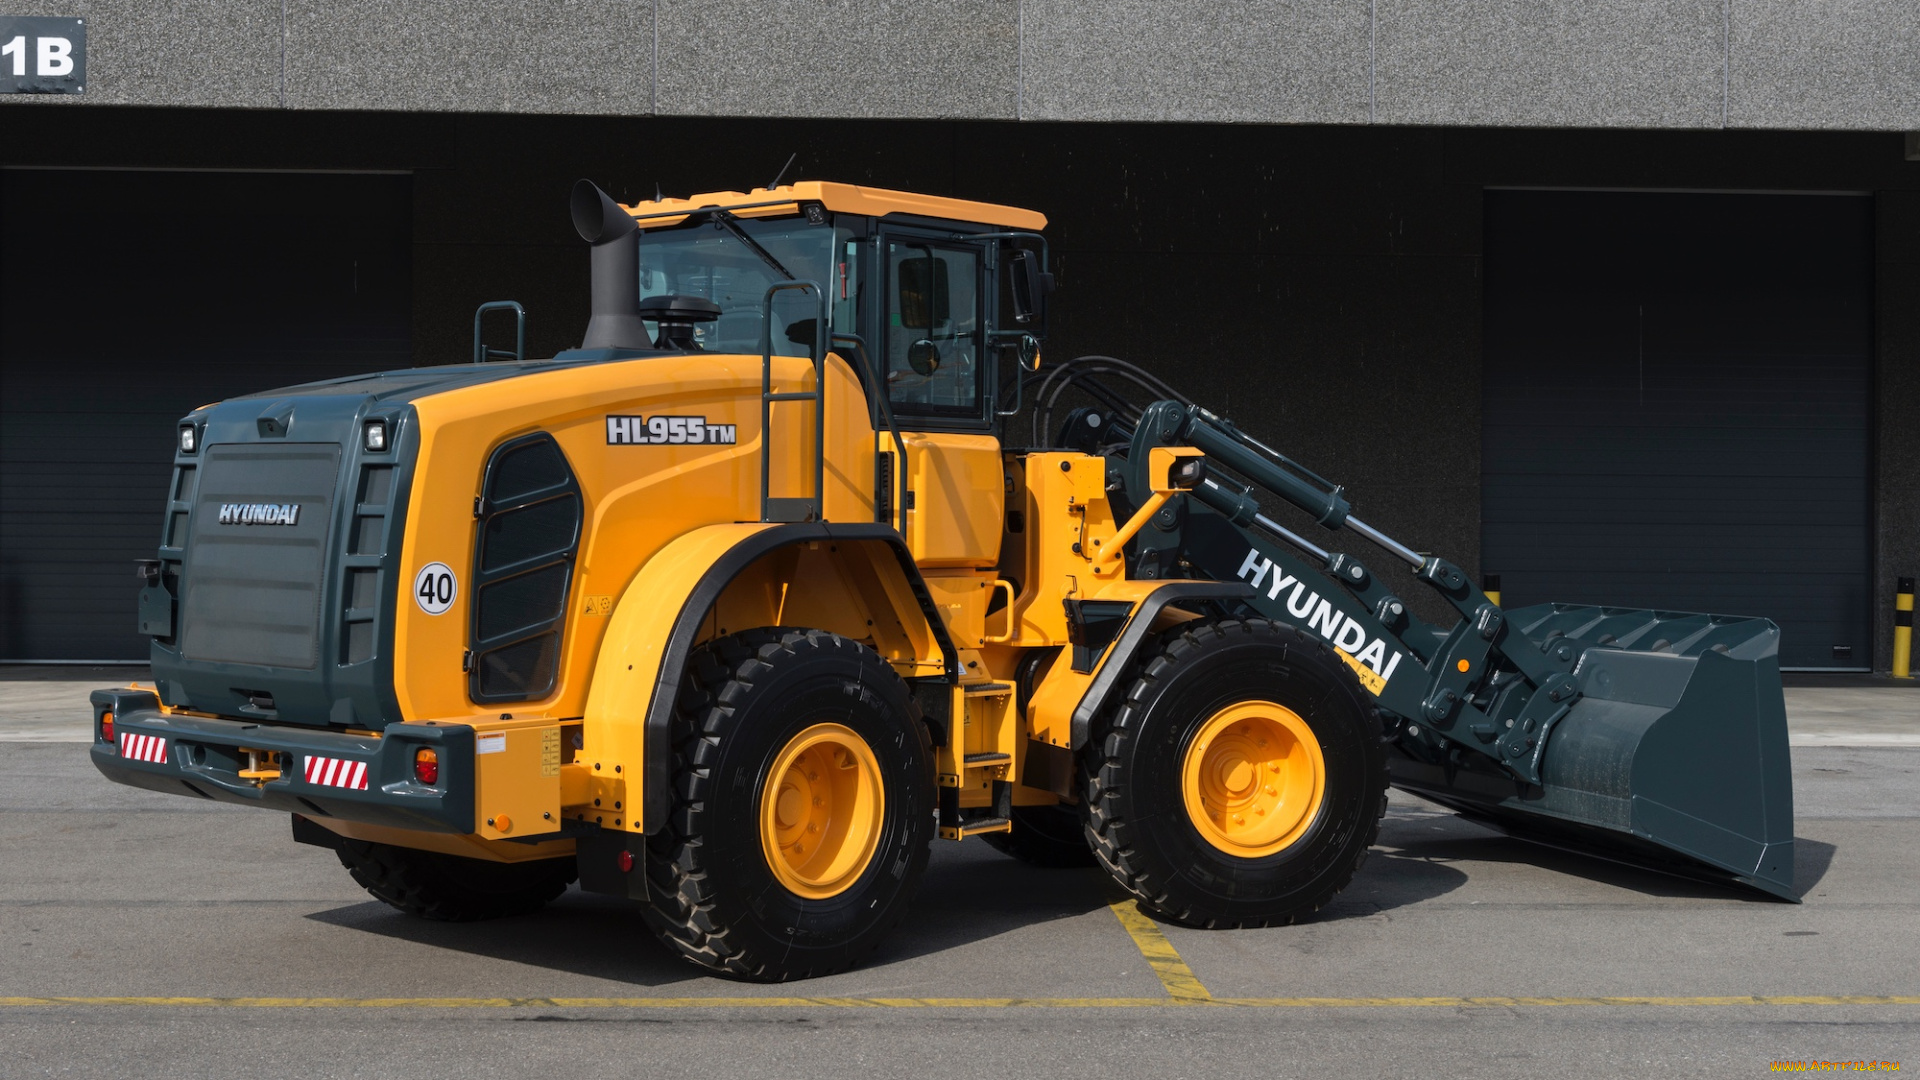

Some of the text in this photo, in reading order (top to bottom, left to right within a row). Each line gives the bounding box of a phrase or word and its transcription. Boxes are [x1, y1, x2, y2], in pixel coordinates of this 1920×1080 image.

[2, 35, 74, 76] 1B
[219, 503, 300, 525] HYUNDAI
[419, 572, 453, 604] 40
[1236, 547, 1403, 682] HYUNDAI
